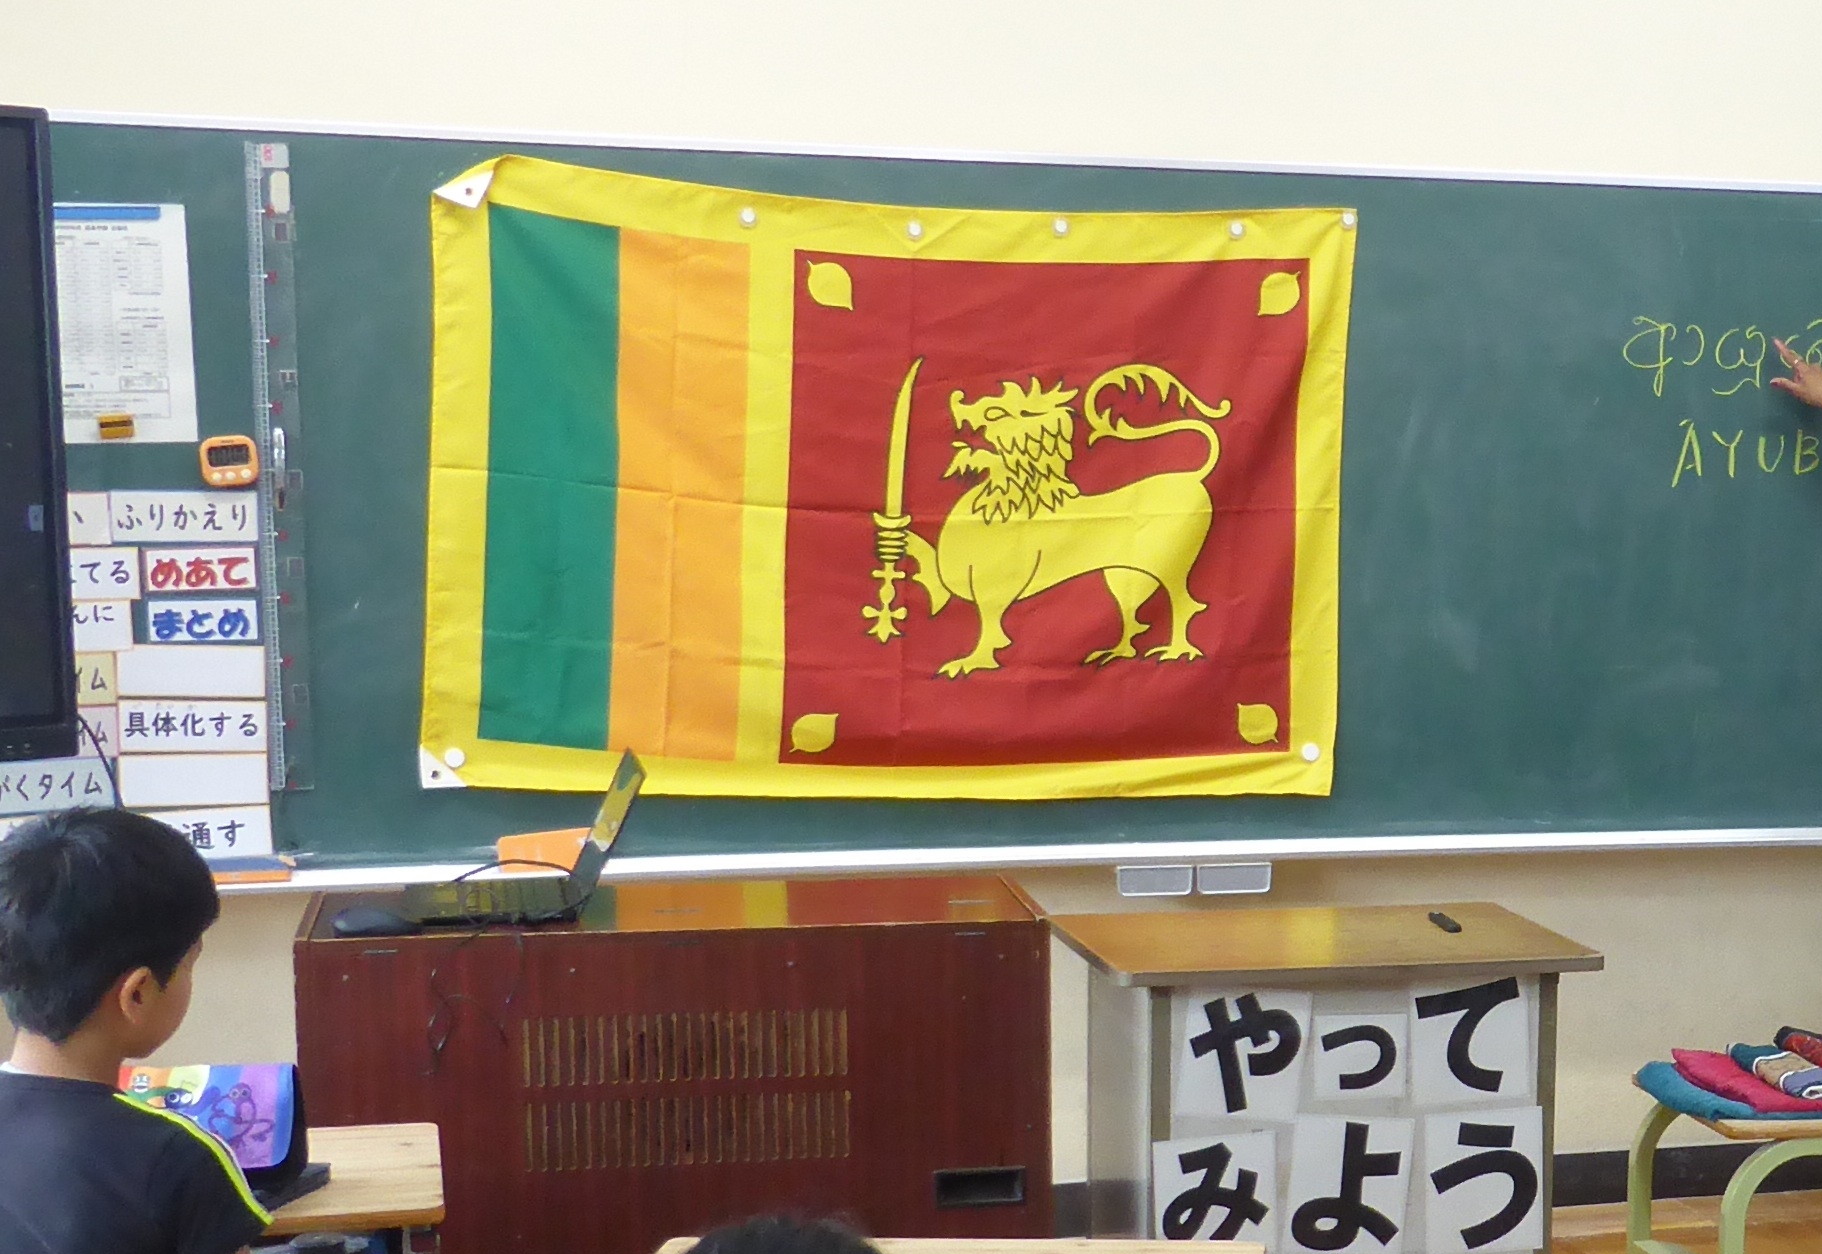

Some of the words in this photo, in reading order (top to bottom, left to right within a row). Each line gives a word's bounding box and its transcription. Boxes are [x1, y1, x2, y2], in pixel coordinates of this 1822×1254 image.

[117, 503, 247, 532] ふりかえり
[150, 556, 250, 590] めあて
[152, 607, 251, 641] まとめ
[124, 711, 259, 738] 具体化する
[1190, 976, 1520, 1113] やって
[1162, 1121, 1539, 1252] みよう
